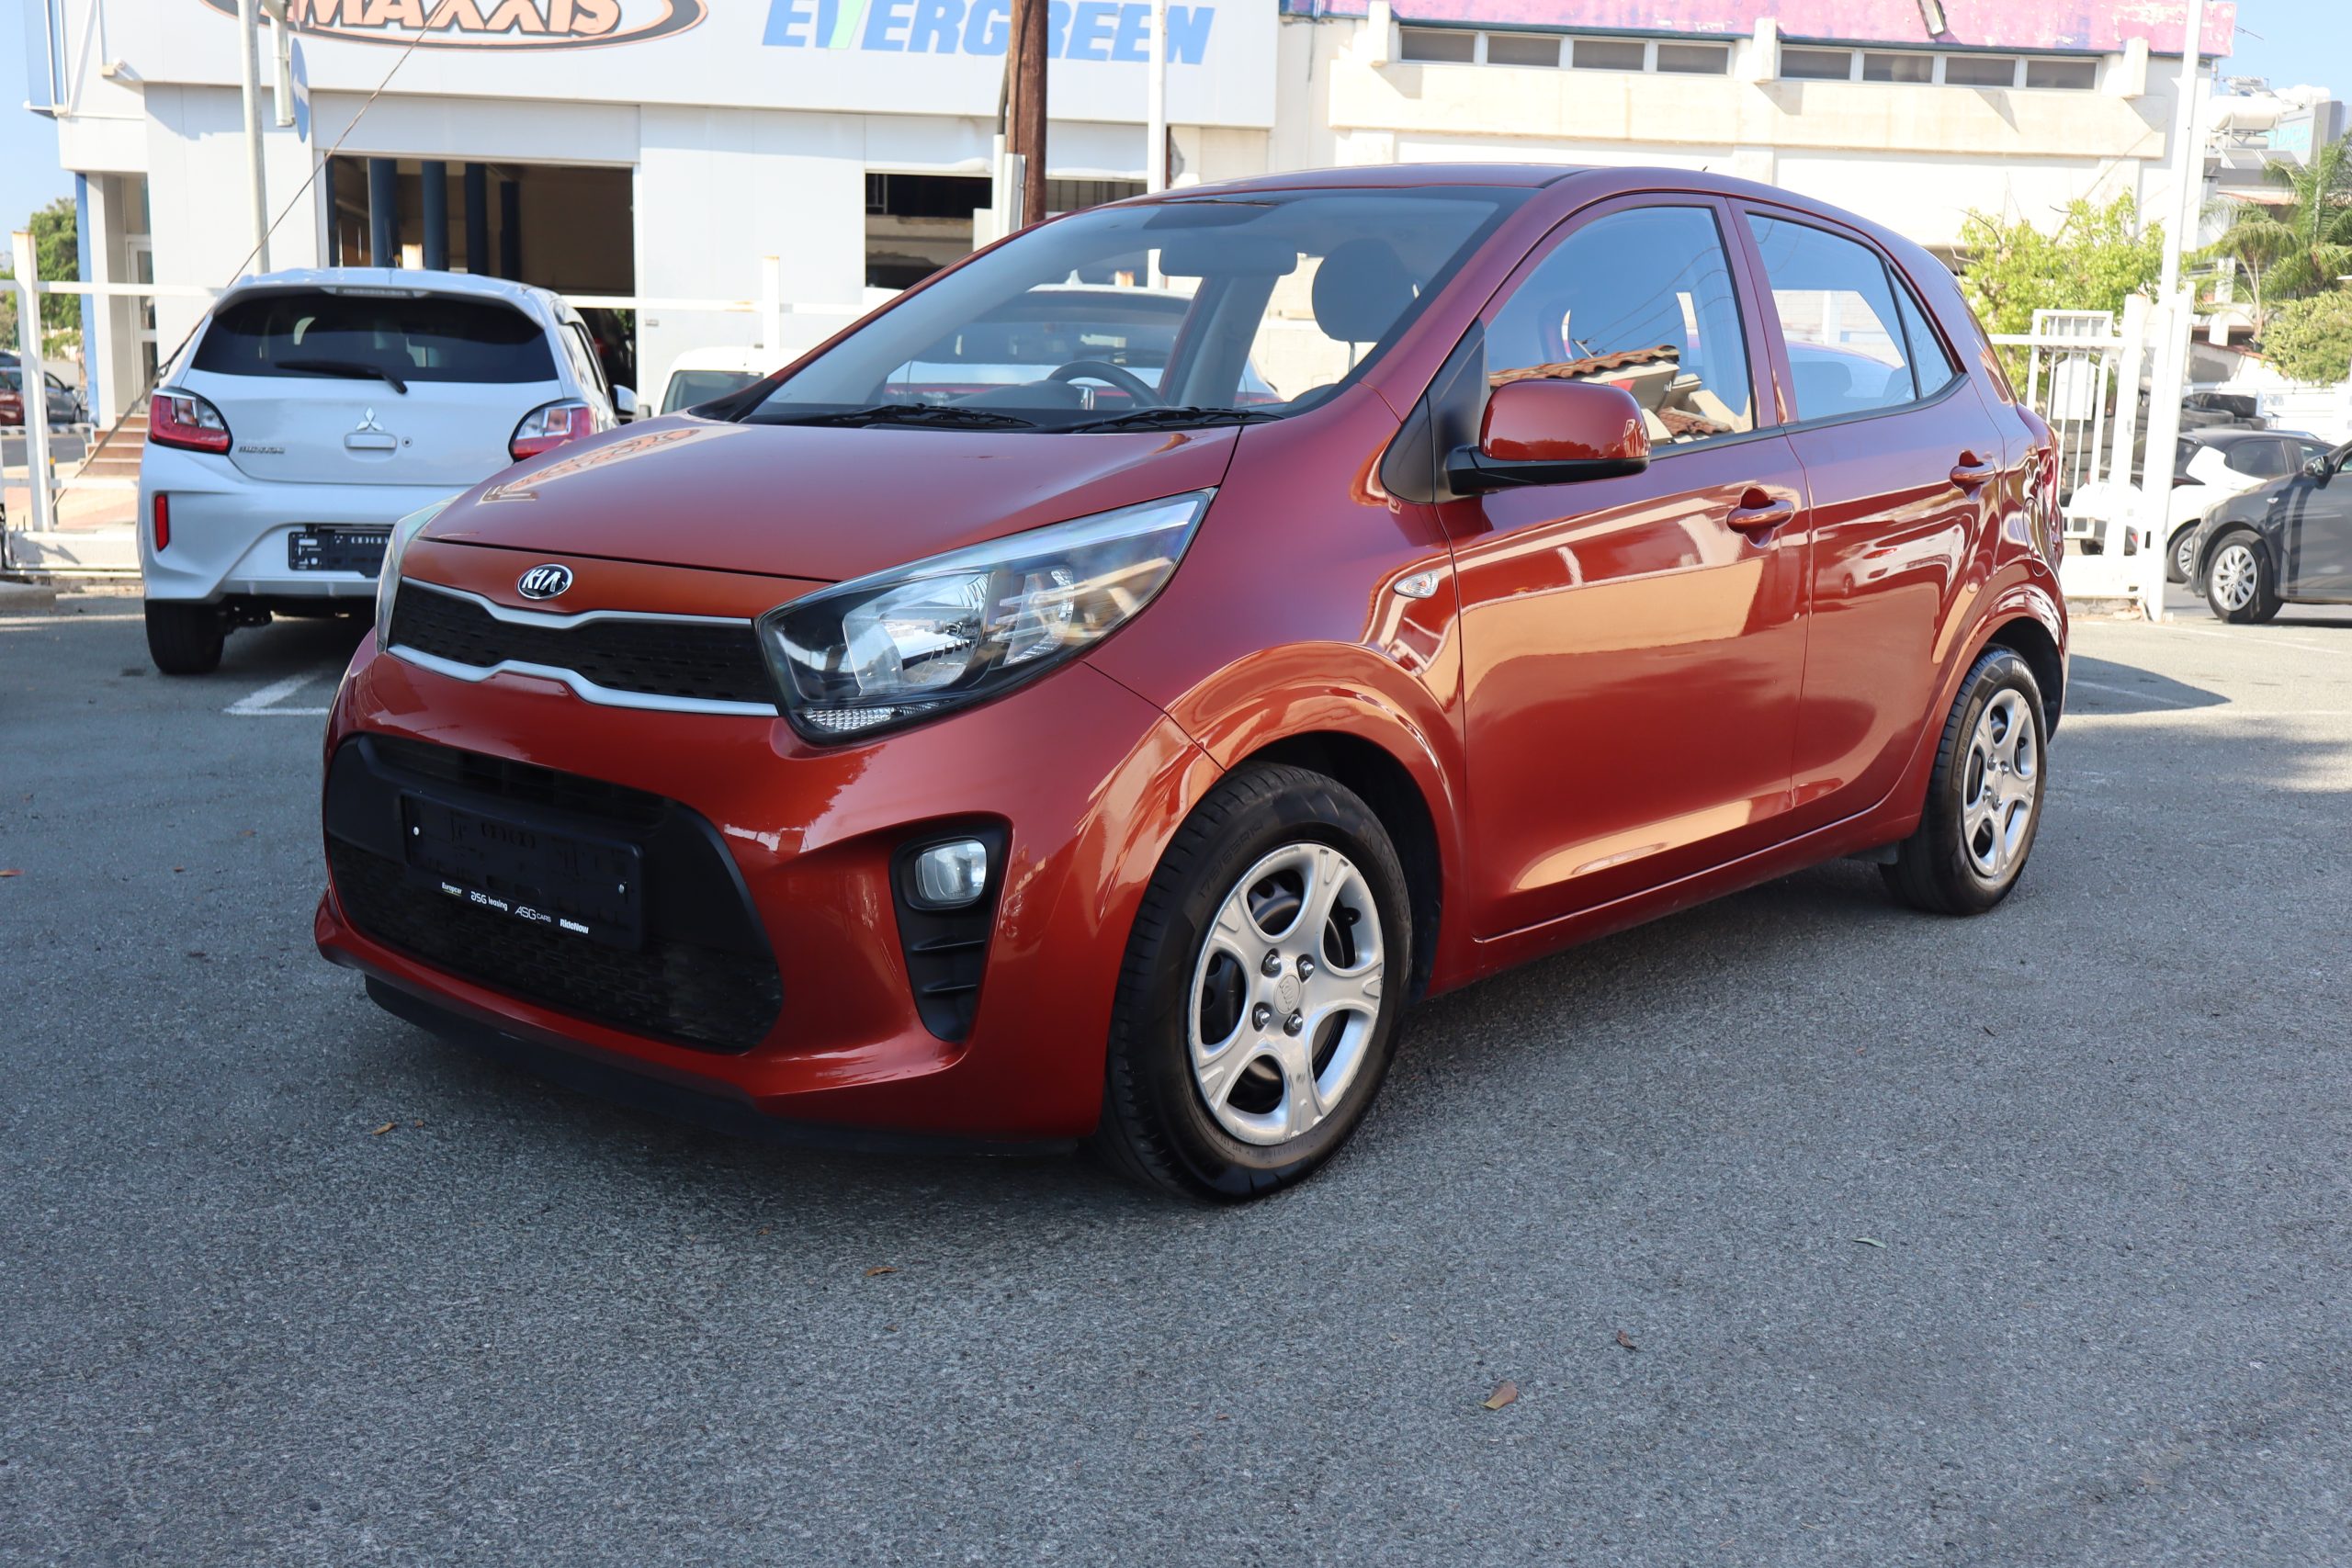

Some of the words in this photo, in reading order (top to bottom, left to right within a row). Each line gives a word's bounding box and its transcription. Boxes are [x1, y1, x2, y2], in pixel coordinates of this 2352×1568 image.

[521, 569, 562, 592] KIA
[441, 881, 462, 895] Europcar
[488, 897, 508, 912] leasing
[514, 906, 537, 920] ASG
[537, 912, 552, 923] CARS
[560, 919, 590, 934] RideNow
